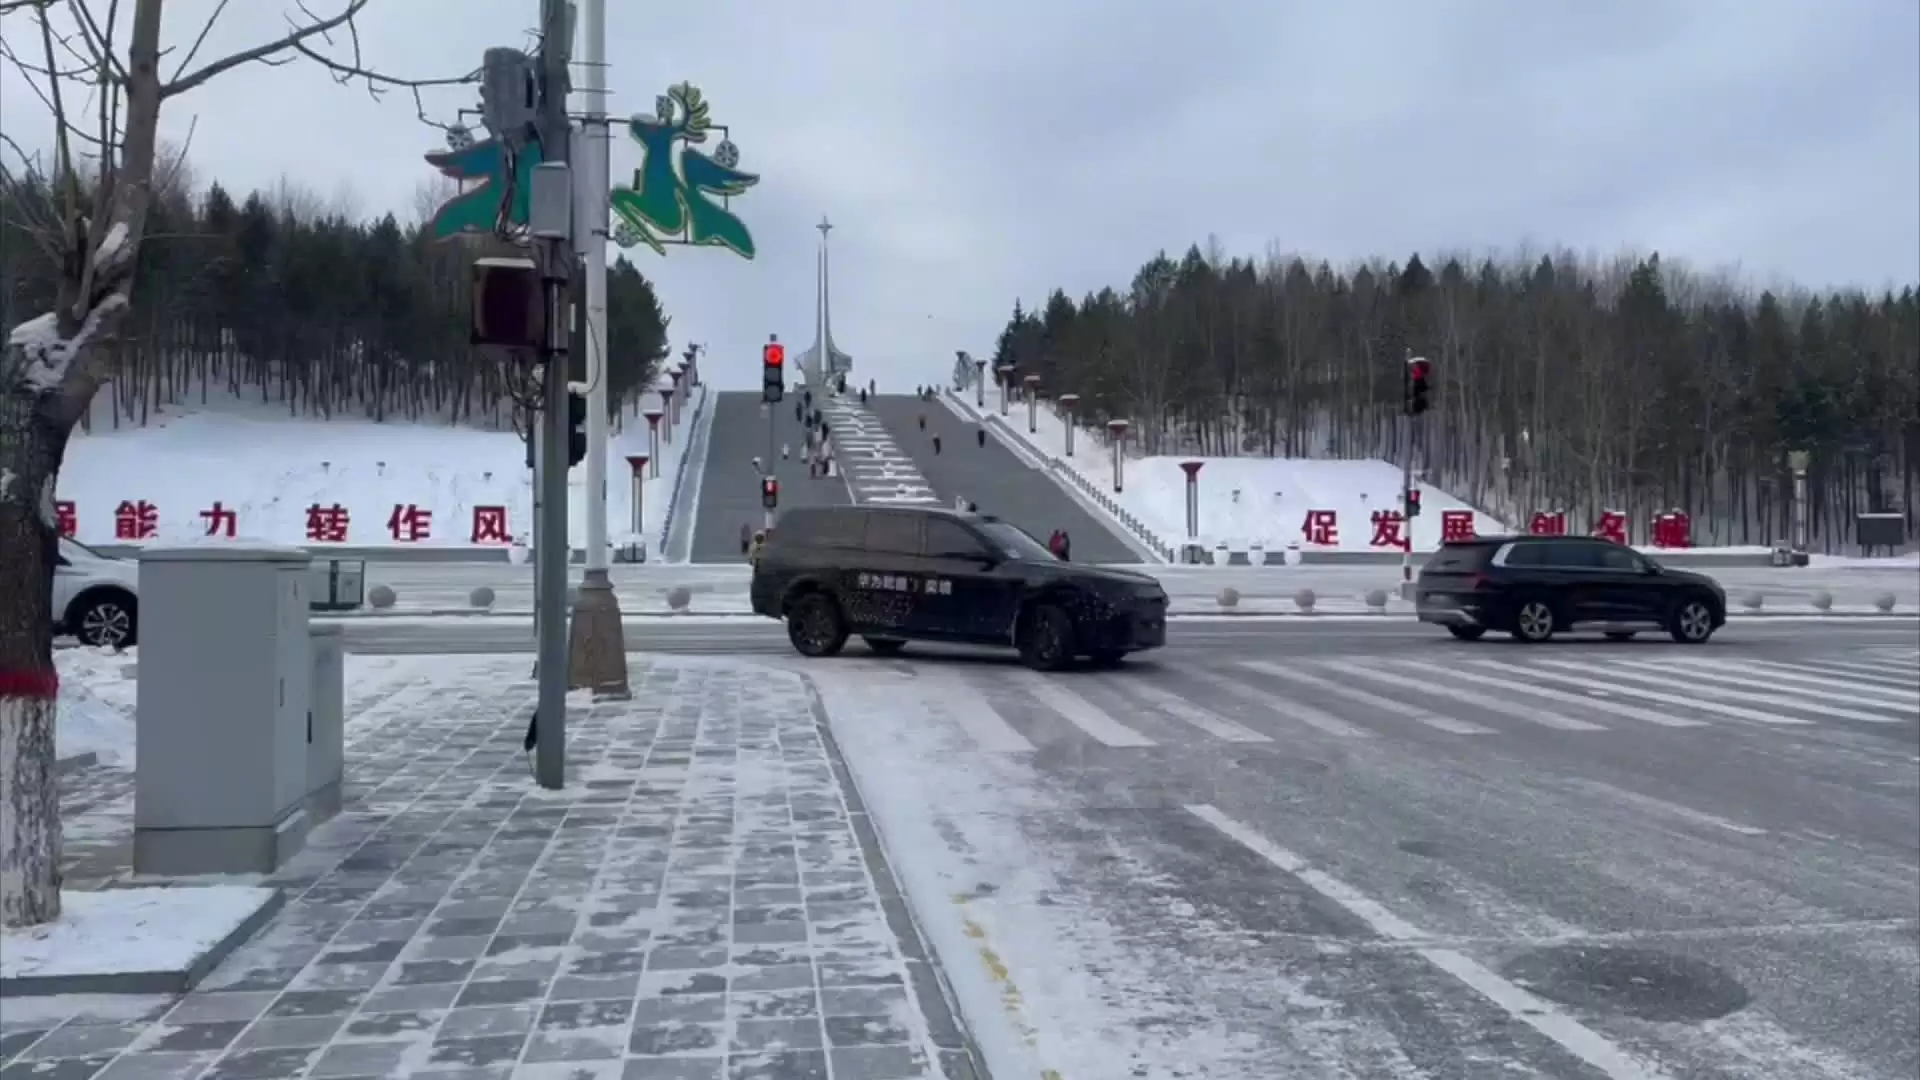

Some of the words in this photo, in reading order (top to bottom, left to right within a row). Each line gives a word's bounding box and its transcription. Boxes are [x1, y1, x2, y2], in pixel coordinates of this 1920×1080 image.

[305, 503, 513, 543] 转作风
[1302, 509, 1476, 547] 促发展
